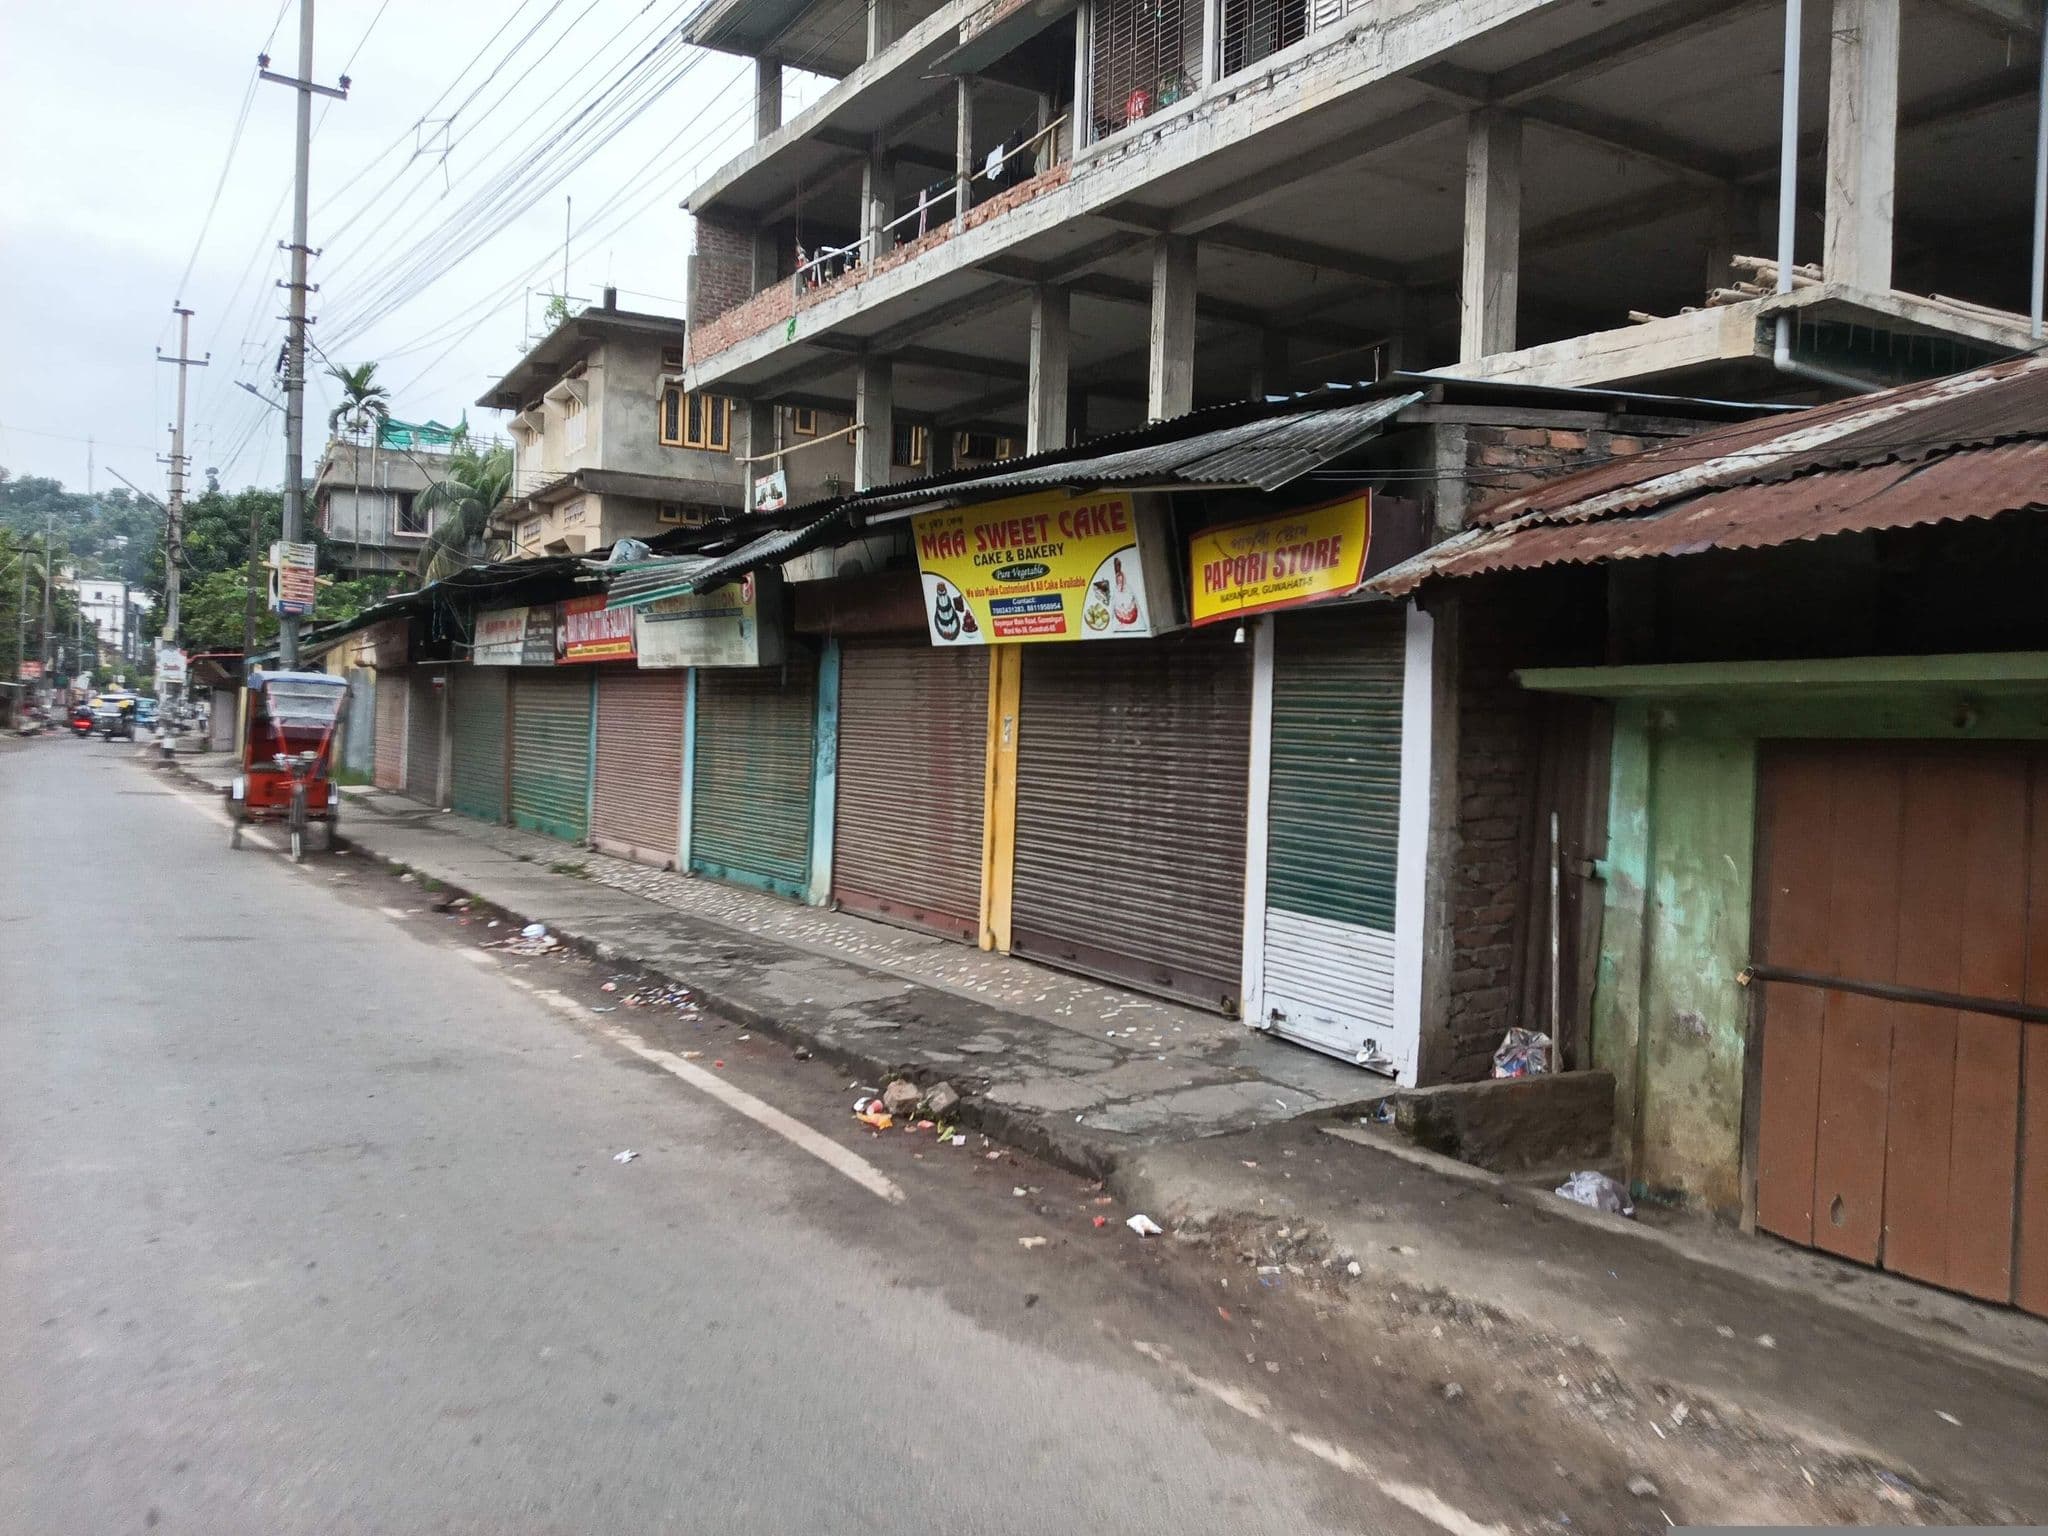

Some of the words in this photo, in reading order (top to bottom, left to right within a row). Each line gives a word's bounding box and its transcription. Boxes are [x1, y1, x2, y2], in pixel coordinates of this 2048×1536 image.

[921, 528, 967, 560] MAA
[974, 513, 1051, 552] SWEET
[1058, 501, 1127, 541] CAKE
[973, 552, 1003, 567] CAKE
[1006, 550, 1015, 562] &
[1017, 543, 1064, 561] BAKERY
[1203, 551, 1268, 594] PAPORI
[1272, 535, 1343, 579] STORE
[996, 570, 1011, 579] Pure
[1012, 564, 1044, 580] Vegetable
[985, 586, 999, 596] Make
[1030, 583, 1035, 592] &
[1044, 580, 1058, 590] Cake
[1060, 576, 1085, 588] Available
